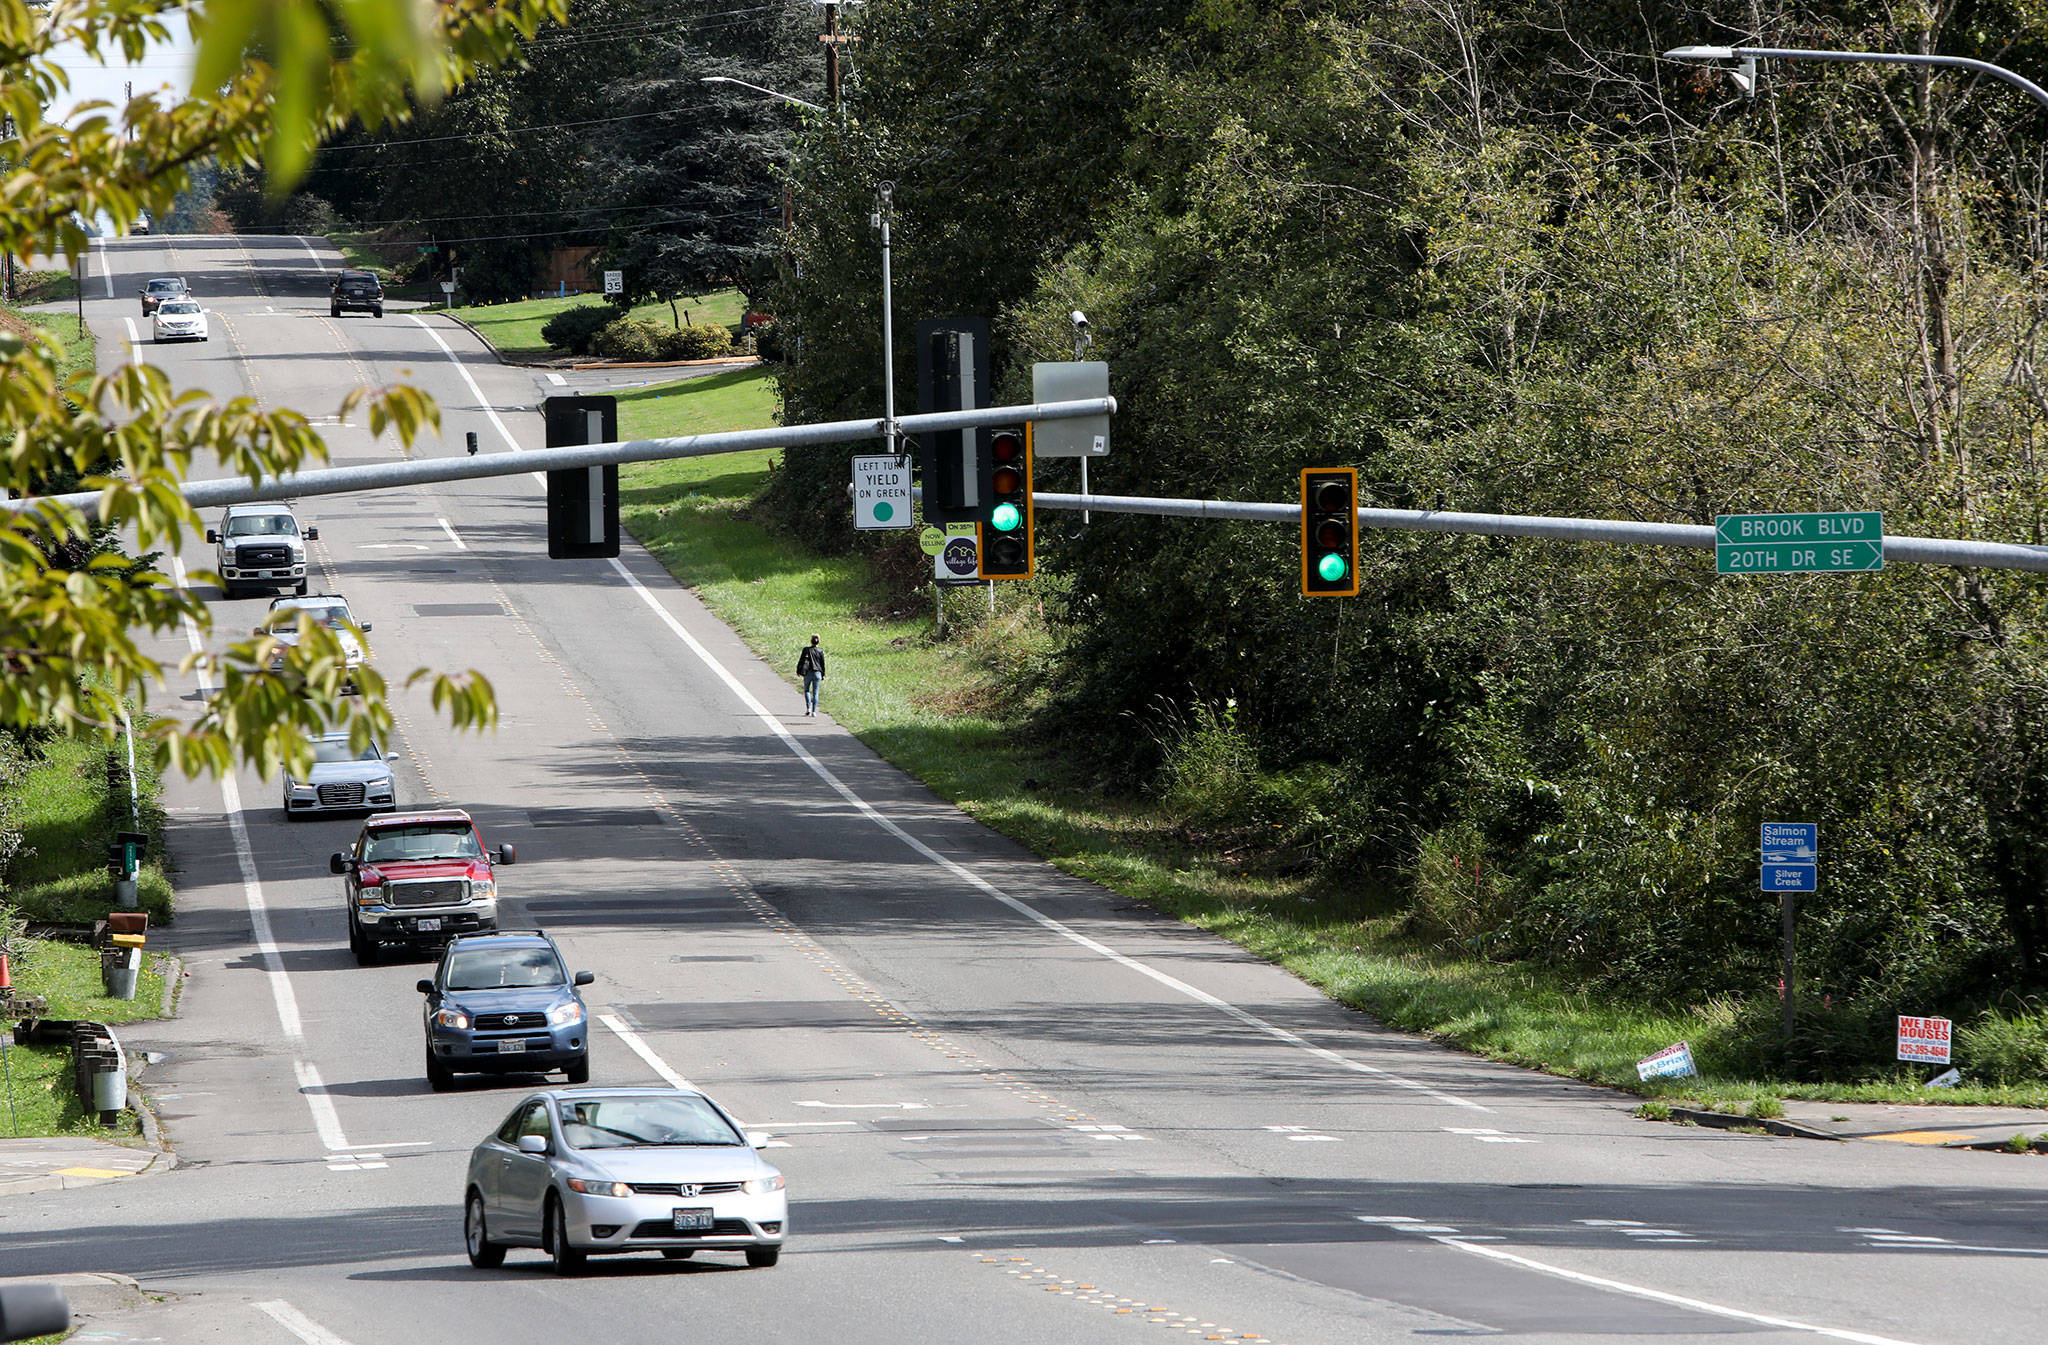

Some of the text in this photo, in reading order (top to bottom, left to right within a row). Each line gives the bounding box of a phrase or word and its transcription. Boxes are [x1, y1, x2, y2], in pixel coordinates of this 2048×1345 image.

[607, 282, 621, 291] 35
[858, 462, 879, 471] LEFT
[866, 474, 899, 485] YIELD
[859, 488, 906, 498] ON GREEN
[1741, 517, 1865, 537] BROOK BLVD
[1729, 549, 1854, 568] 20TH DR SE
[1764, 826, 1807, 836] Salmon
[1764, 836, 1805, 846] Stream
[1775, 869, 1803, 878] Silver
[1775, 877, 1802, 886] Creek
[1900, 1017, 1949, 1030] WE BUY
[1900, 1027, 1949, 1041] HOUSES
